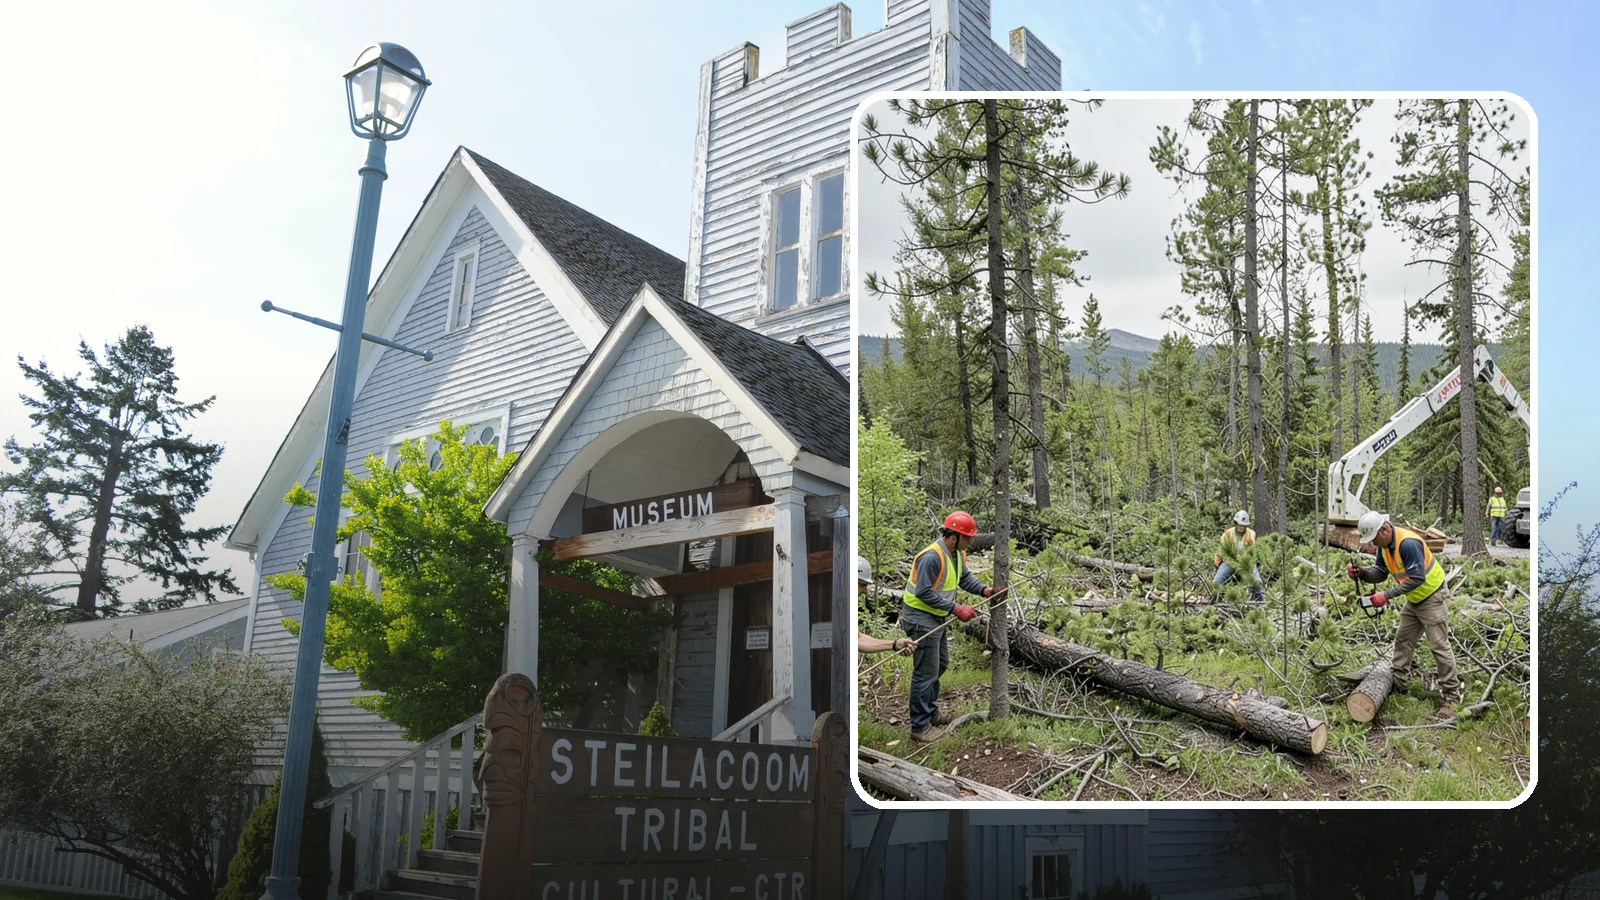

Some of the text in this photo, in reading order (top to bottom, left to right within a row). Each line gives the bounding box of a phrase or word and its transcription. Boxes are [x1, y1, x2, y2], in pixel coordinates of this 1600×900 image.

[613, 491, 713, 531] MUSEUM
[550, 738, 810, 792] STEILACOOM
[614, 806, 758, 852] TRIBAL
